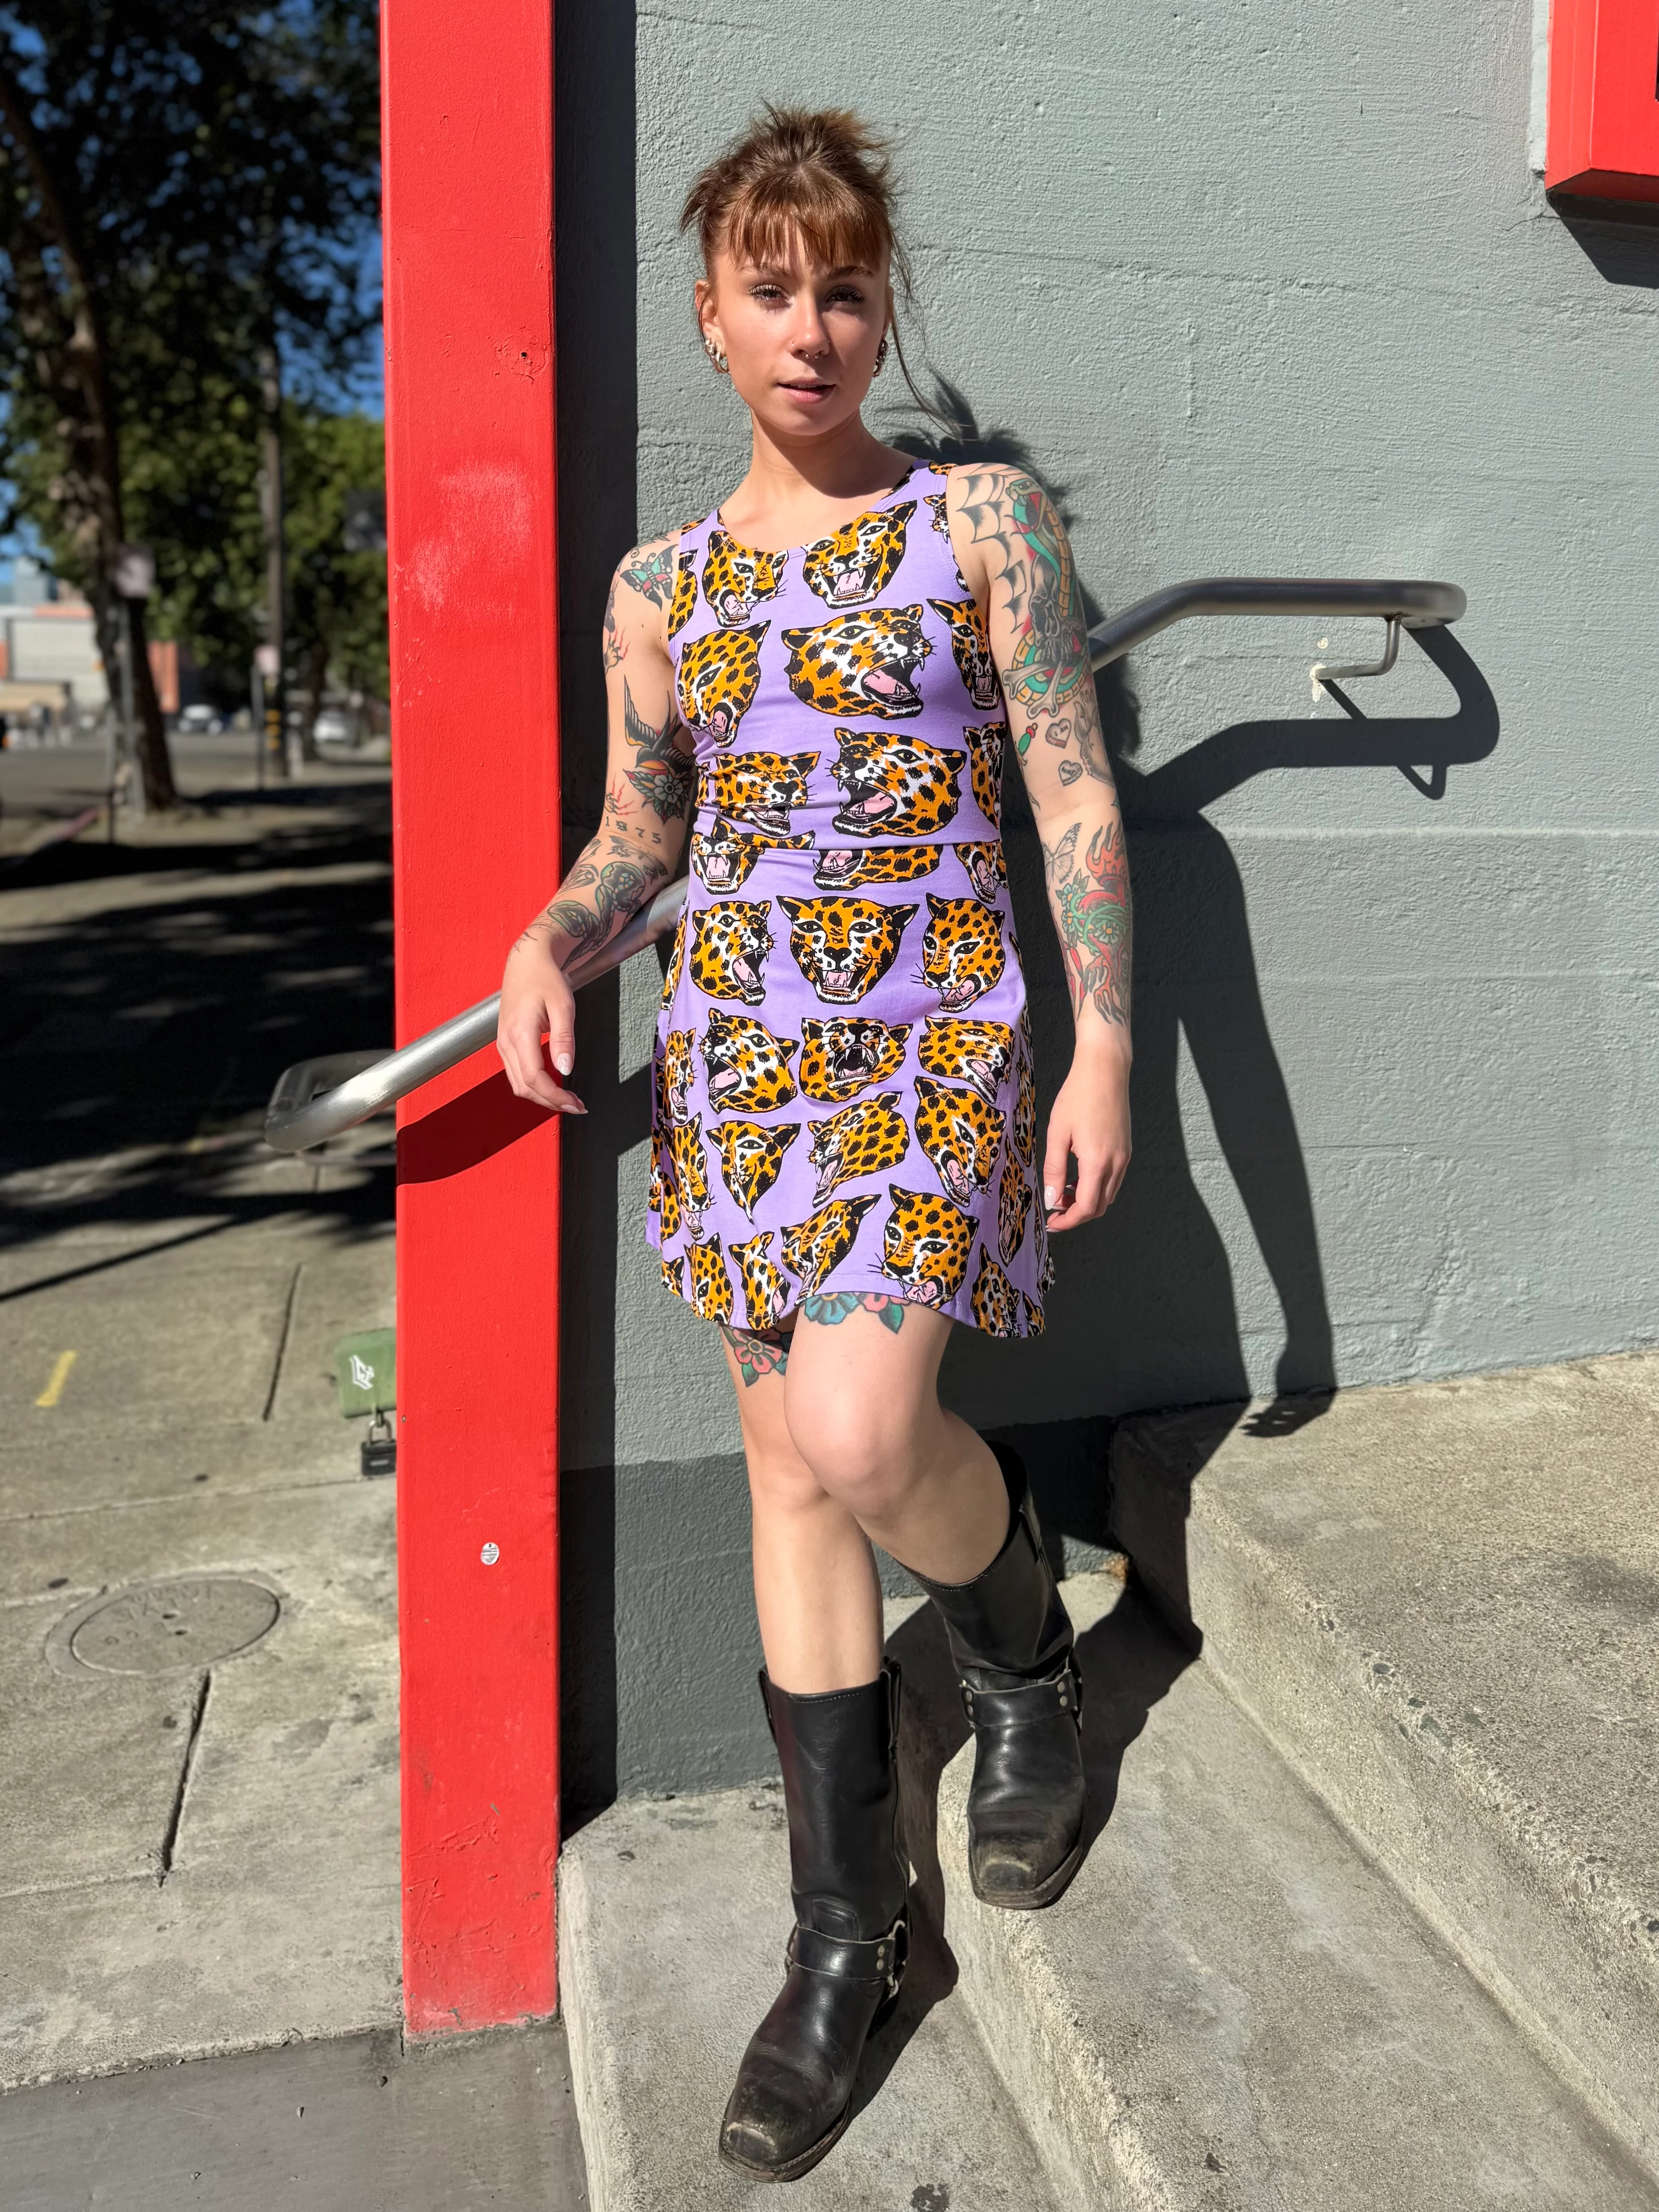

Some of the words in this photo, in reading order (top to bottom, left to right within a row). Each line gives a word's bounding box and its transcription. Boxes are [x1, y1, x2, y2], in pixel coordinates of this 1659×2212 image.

[1060, 725, 1068, 734] AM
[1061, 767, 1075, 776] MINE
[605, 816, 662, 844] 1975
